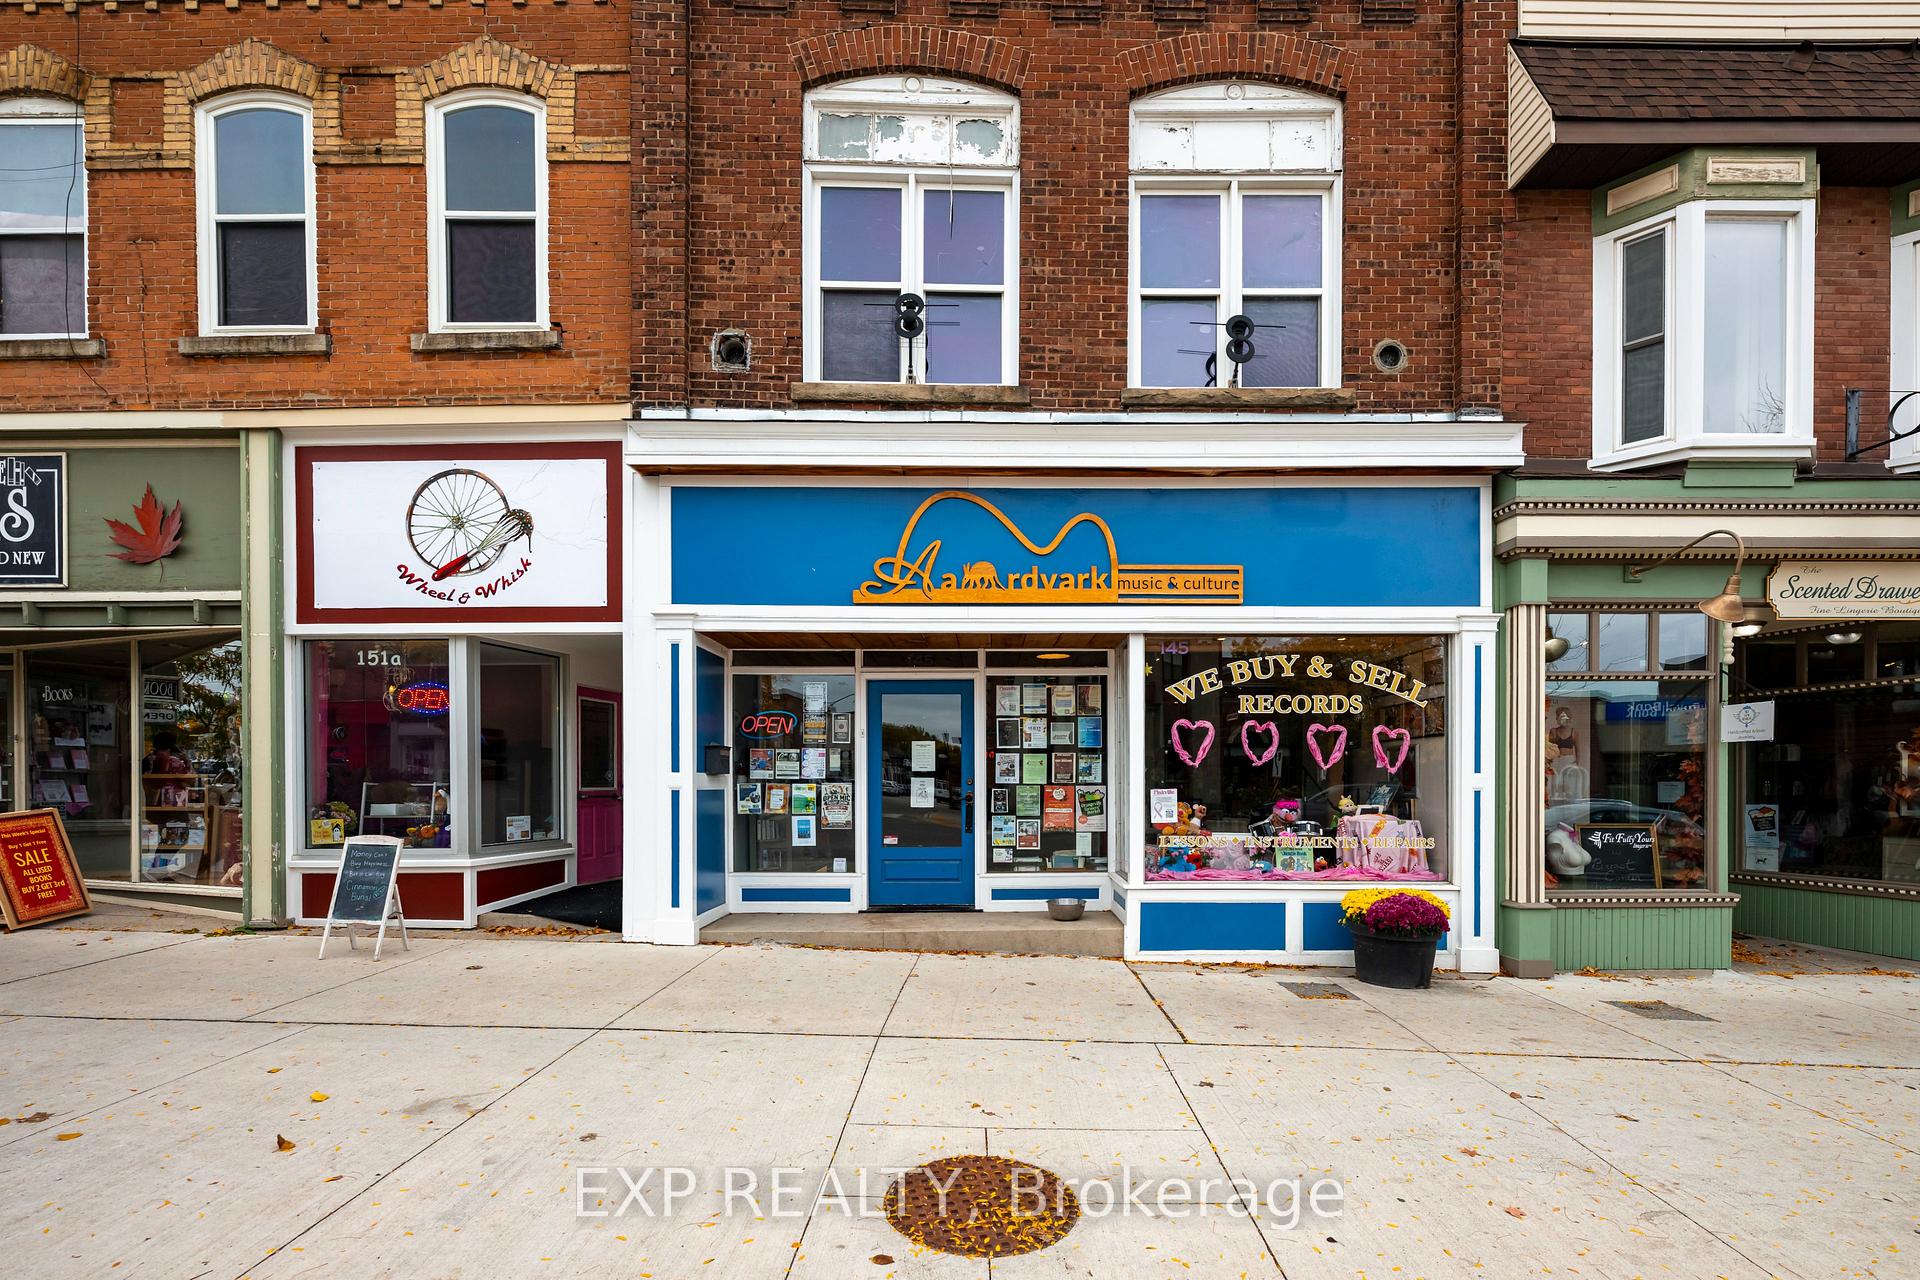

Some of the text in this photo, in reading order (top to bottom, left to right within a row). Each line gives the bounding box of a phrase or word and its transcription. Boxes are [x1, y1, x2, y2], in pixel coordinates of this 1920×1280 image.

[12, 551, 46, 565] NEW
[860, 540, 1109, 600] Aardvark
[1800, 565, 1822, 574] The
[397, 557, 532, 604] Wheel & Whisk
[1118, 576, 1240, 590] music & culture
[1780, 574, 1854, 599] Scented
[1809, 605, 1831, 614] Fine
[1833, 605, 1879, 616] Lingerie
[1160, 641, 1189, 655] 145
[357, 650, 402, 666] 151a
[1164, 654, 1429, 709] WE BUY & SELL
[1237, 694, 1364, 715] RECORDS
[741, 715, 794, 735] OPEN
[30, 828, 46, 836] Special
[1602, 832, 1656, 845] Fit Fully Yours
[1158, 835, 1436, 849] LESSONS INSTRUMENTS REPAIRS
[13, 848, 52, 867] SALE
[23, 865, 53, 877] ALL USED
[29, 874, 53, 884] BOOKS
[21, 886, 36, 894] BUY
[41, 882, 53, 890] GET
[54, 880, 66, 888] 3rd
[37, 890, 57, 899] FREE!
